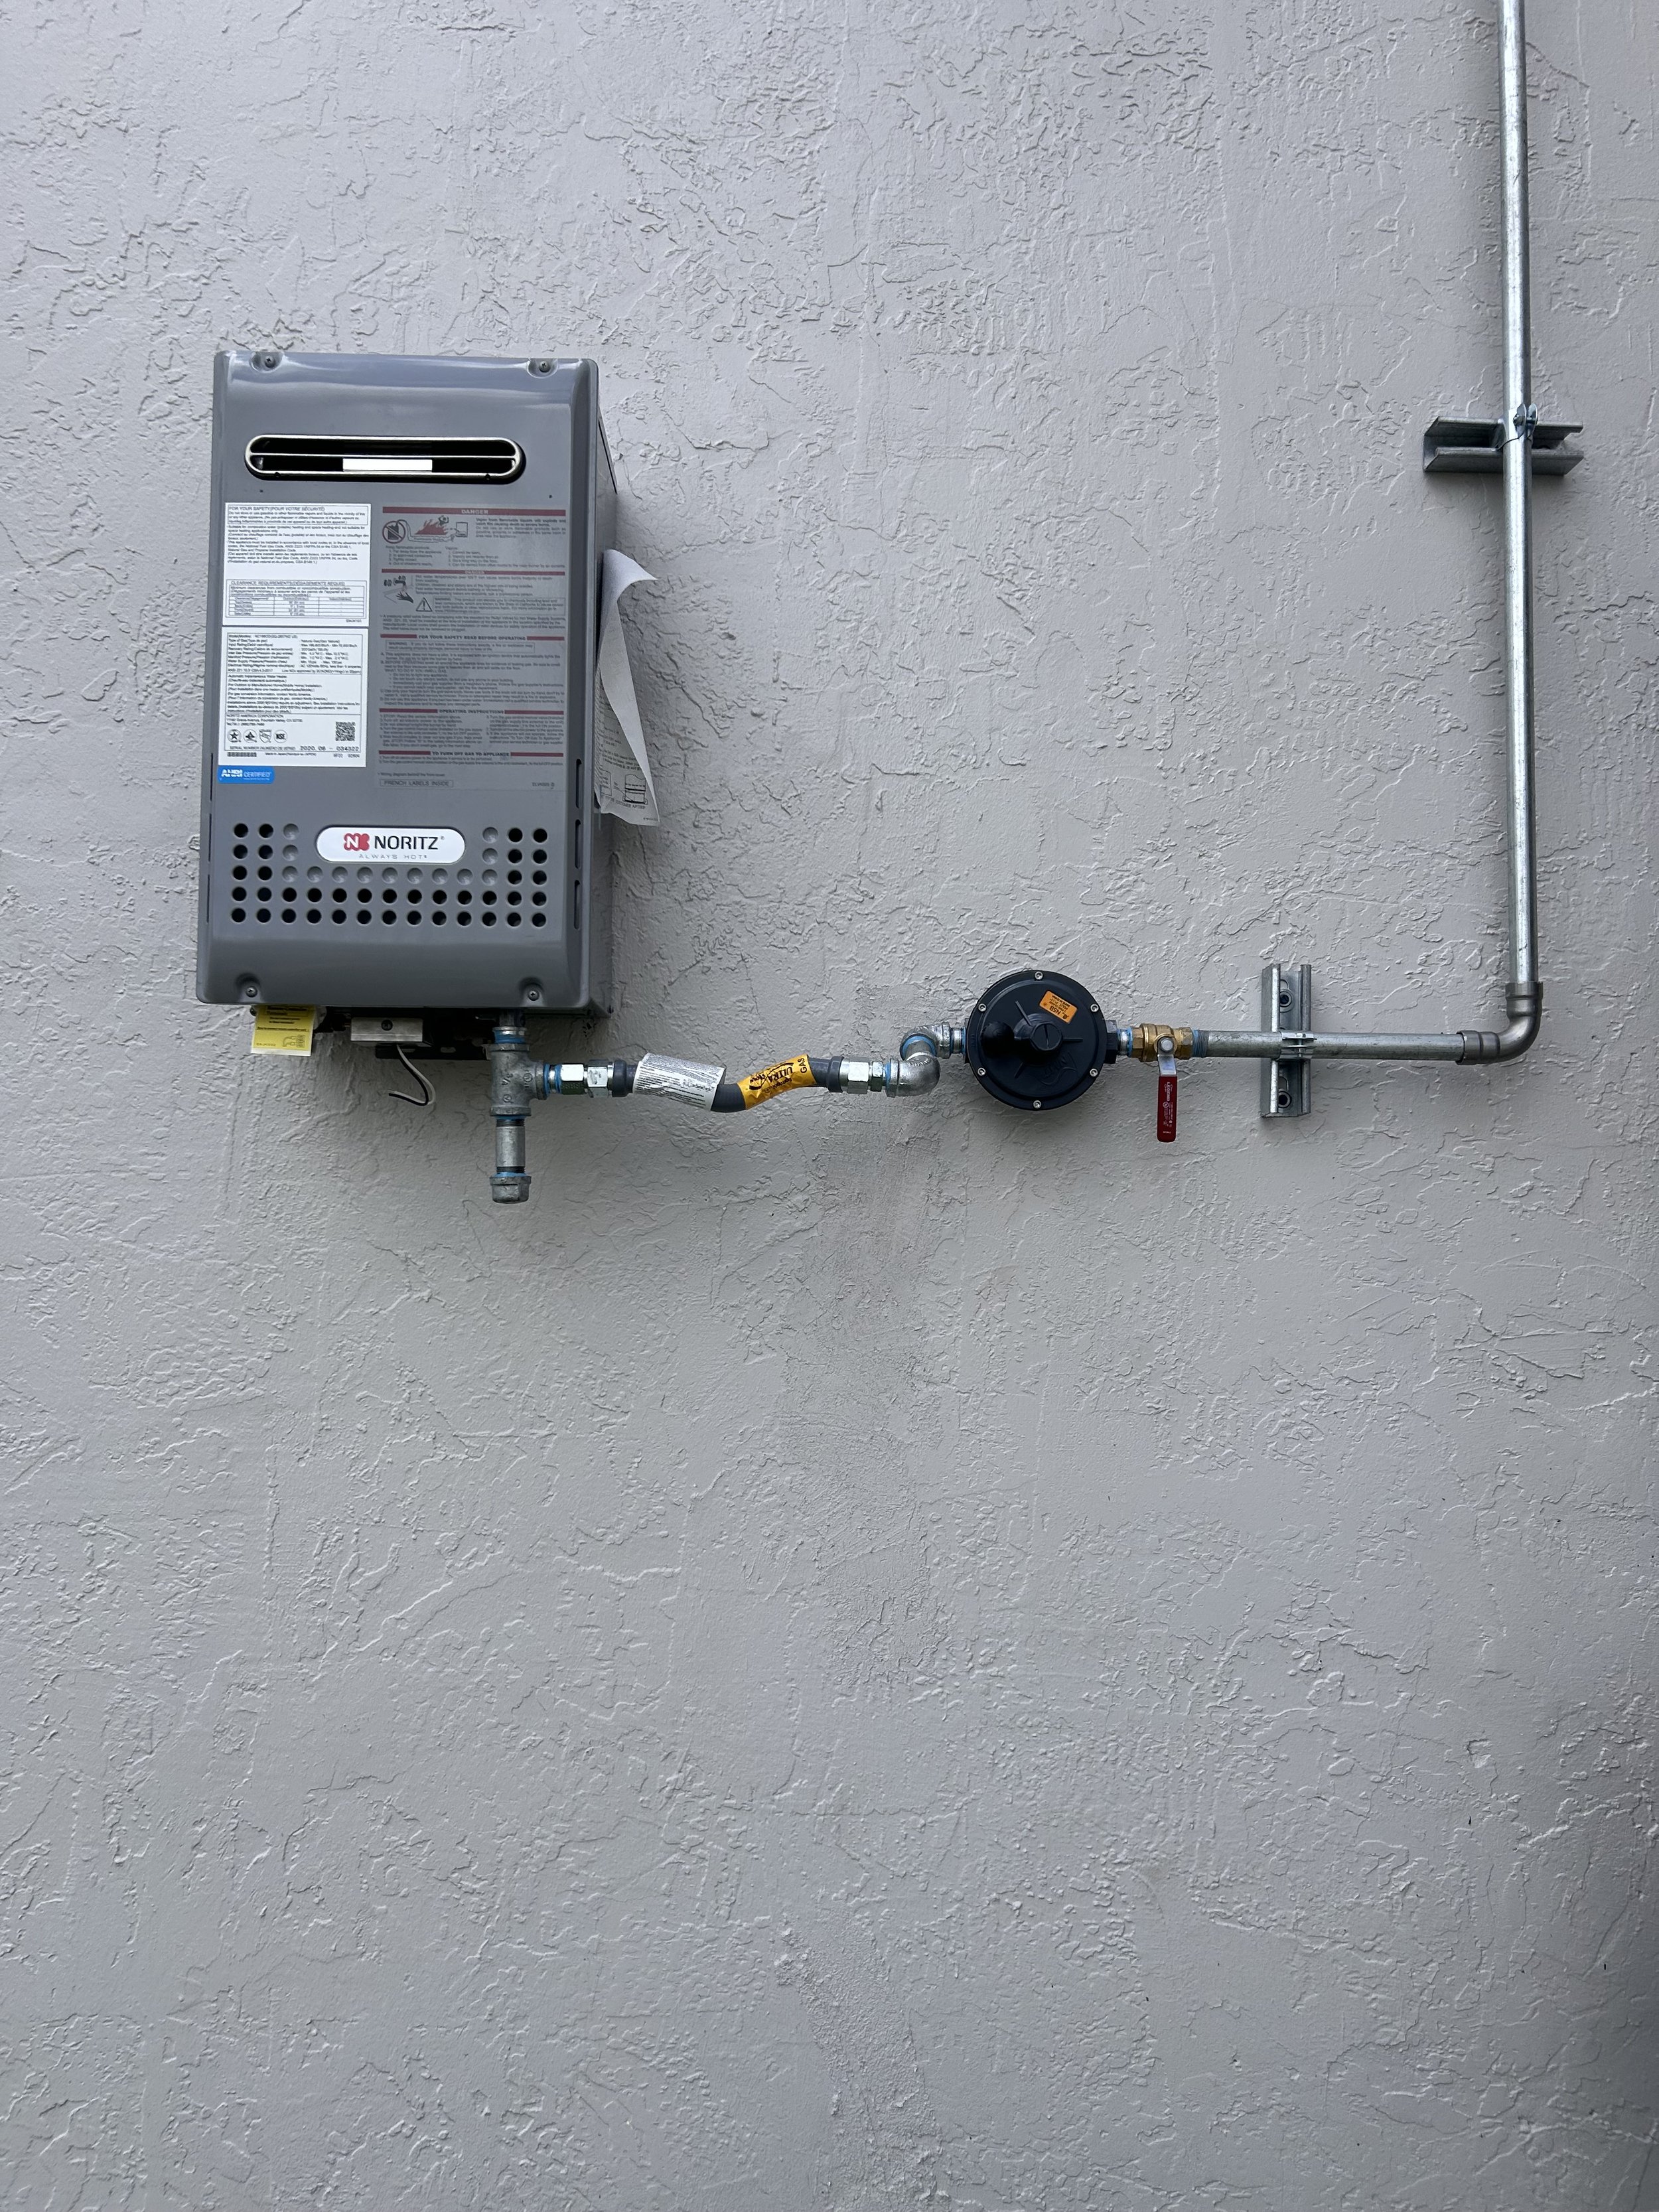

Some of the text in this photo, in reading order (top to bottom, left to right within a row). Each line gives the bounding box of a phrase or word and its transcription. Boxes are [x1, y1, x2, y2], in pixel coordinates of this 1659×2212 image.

[374, 836, 439, 849] NORITZ
[797, 1058, 808, 1074] GAS
[768, 1067, 793, 1083] ULTRA
